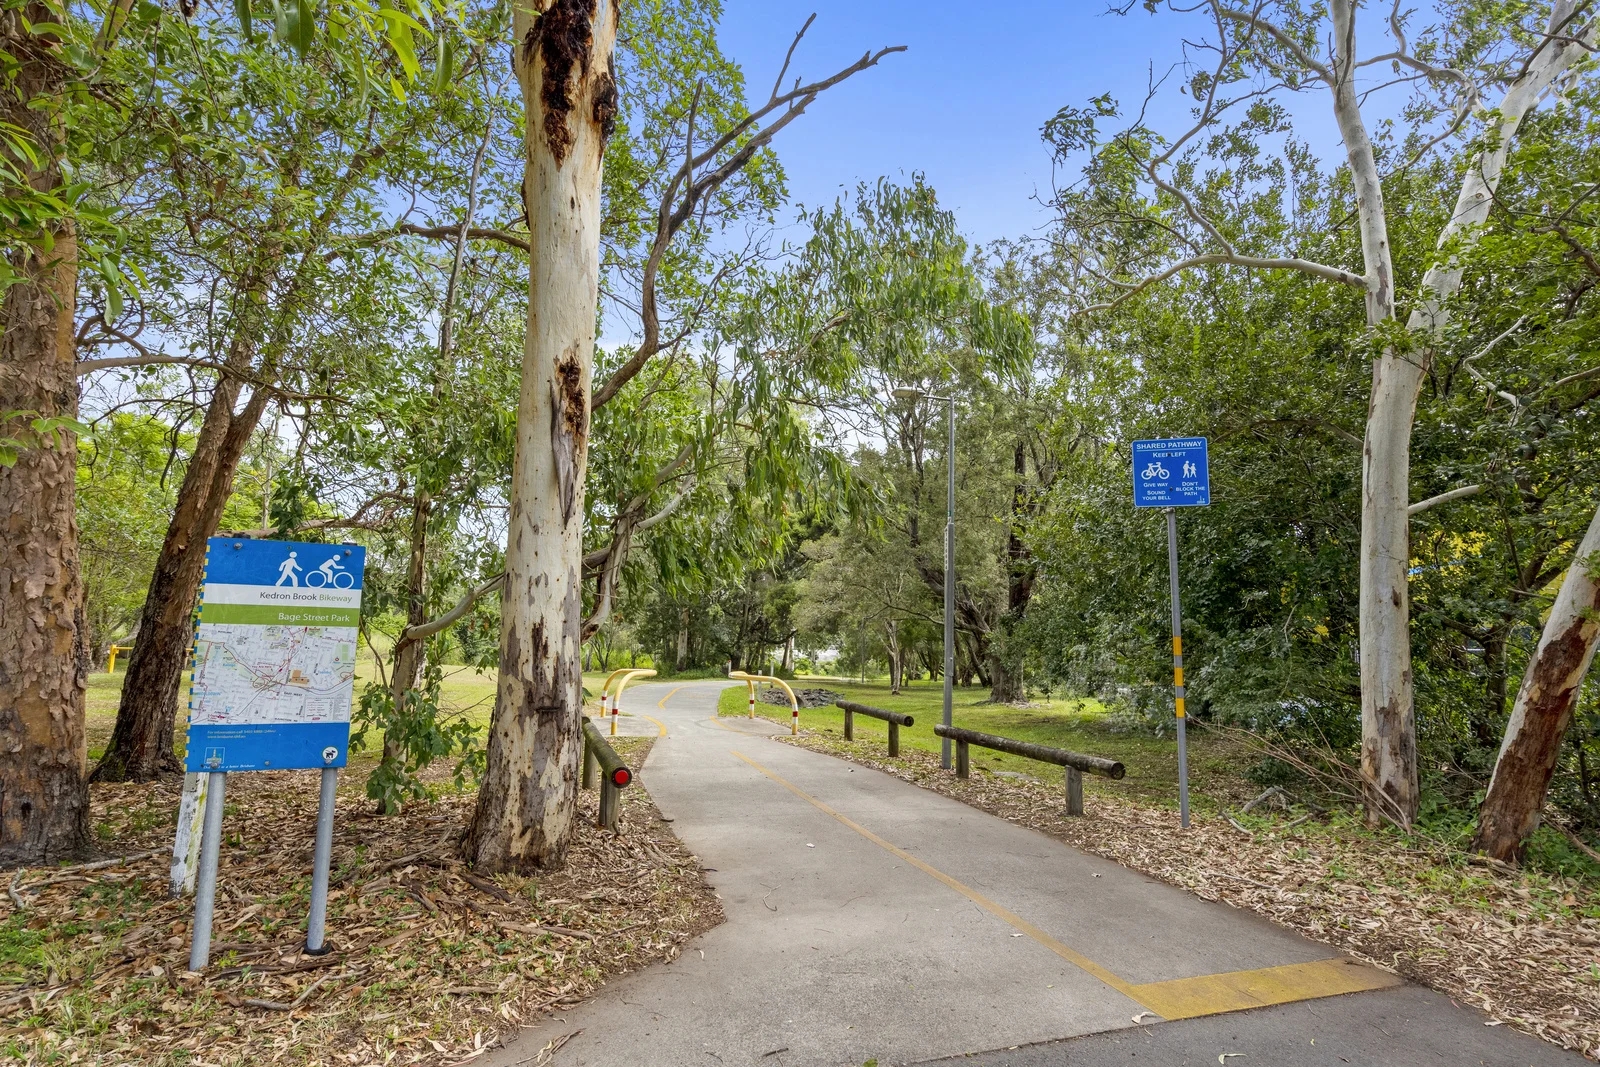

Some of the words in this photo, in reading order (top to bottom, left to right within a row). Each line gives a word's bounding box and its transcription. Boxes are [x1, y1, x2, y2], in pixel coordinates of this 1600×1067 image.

[260, 592, 290, 600] Kedron
[293, 593, 317, 601] Brook
[319, 594, 352, 603] Bikeway
[278, 613, 300, 622] Bage
[303, 613, 329, 621] Street
[331, 614, 350, 622] Park
